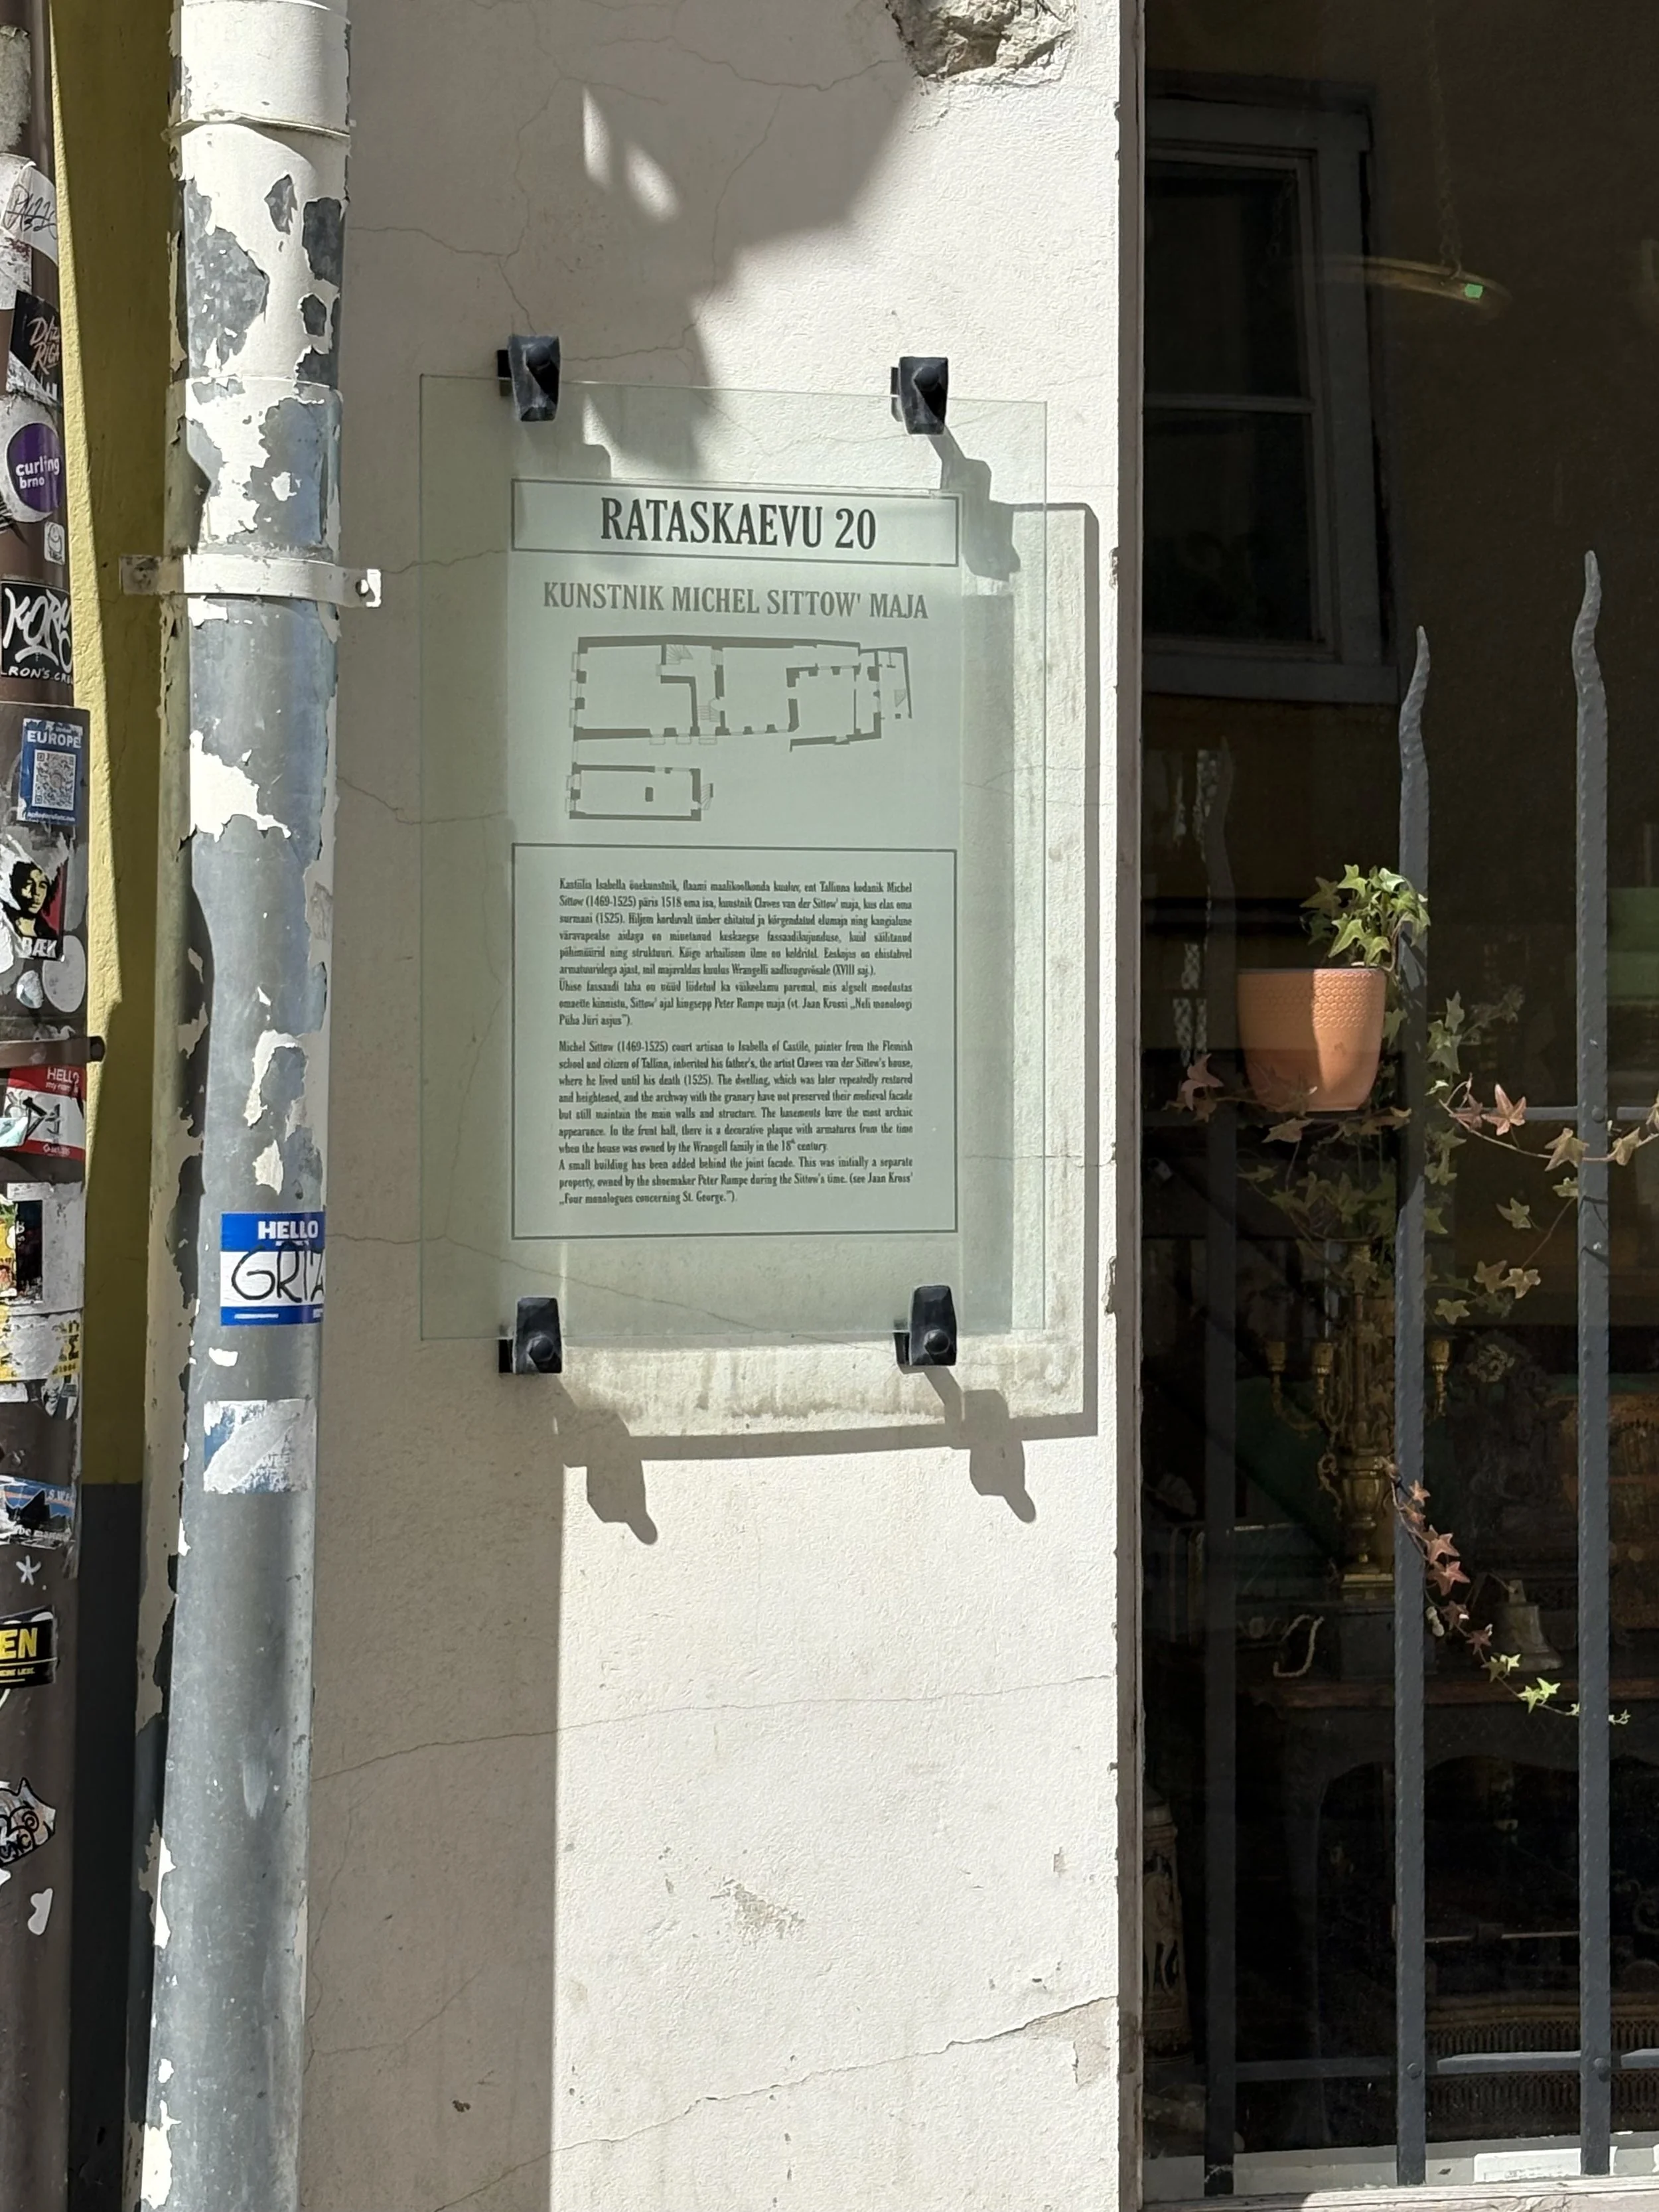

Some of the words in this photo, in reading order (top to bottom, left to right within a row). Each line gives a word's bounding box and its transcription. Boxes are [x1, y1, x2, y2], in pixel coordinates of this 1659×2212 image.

[15, 456, 60, 476] curling
[19, 477, 46, 489] brno
[599, 497, 823, 548] RATASKAEVU
[834, 508, 877, 550] 20
[543, 581, 664, 611] KUNSTNIK
[672, 585, 760, 615] MICHEL
[766, 589, 861, 617] SITTOW'
[869, 593, 929, 620] MAJA
[27, 730, 82, 749] EUROPE
[559, 1040, 587, 1052] Michel
[589, 1041, 614, 1052] Sittow
[616, 1041, 669, 1053] (1469-1525)
[671, 1043, 693, 1052] court
[695, 1041, 724, 1052] artisan
[737, 1040, 769, 1051] Isabella
[814, 1041, 843, 1055] painter
[845, 1040, 864, 1051] from
[882, 1040, 913, 1051] Flemish
[558, 1057, 585, 1069] school
[603, 1058, 630, 1069] citizen
[672, 1057, 709, 1069] inherited
[773, 1058, 796, 1068] artist
[796, 1057, 824, 1068] Clawes
[558, 1074, 583, 1086] where
[598, 1074, 618, 1086] lived
[620, 1074, 640, 1086] until
[658, 1073, 682, 1085] death
[716, 1074, 733, 1085] The
[772, 1073, 798, 1084] which
[817, 1073, 837, 1084] later
[838, 1073, 879, 1087] repeatedly
[881, 1072, 913, 1084] restored
[655, 1090, 689, 1104] archway
[689, 1090, 707, 1102] with
[723, 1094, 756, 1104] granary
[757, 1090, 776, 1102] have
[791, 1090, 831, 1104] preserved
[831, 1090, 852, 1101] their
[888, 1089, 913, 1100] facade
[595, 1108, 631, 1119] maintain
[650, 1108, 672, 1119] main
[674, 1107, 696, 1118] walls
[779, 1106, 821, 1118] basements
[824, 1106, 843, 1118] have
[862, 1108, 882, 1117] most
[885, 1106, 913, 1117] archaic
[637, 1124, 658, 1136] front
[681, 1124, 703, 1136] there
[723, 1124, 764, 1135] decorative
[766, 1124, 794, 1138] plaque
[795, 1123, 814, 1134] with
[816, 1125, 857, 1134] armatures
[859, 1122, 878, 1134] from
[896, 1123, 913, 1134] time
[558, 1142, 581, 1153] when
[596, 1142, 621, 1153] house
[638, 1141, 666, 1153] owned
[691, 1140, 729, 1154] Wrangell
[729, 1140, 755, 1154] family
[568, 1159, 591, 1170] small
[593, 1159, 629, 1173] building
[648, 1158, 669, 1169] been
[671, 1157, 696, 1169] added
[698, 1157, 727, 1169] behind
[745, 1157, 764, 1171] joint
[798, 1156, 817, 1167] This
[837, 1155, 869, 1169] initially
[879, 1157, 913, 1169] separate
[596, 1175, 624, 1187] owned
[651, 1174, 697, 1186] shoemaker
[697, 1174, 719, 1185] Peter
[719, 1174, 749, 1187] Rumpe
[750, 1173, 778, 1187] during
[849, 1173, 866, 1184] (see
[867, 1172, 887, 1183] Jaan
[585, 1192, 634, 1206] monologues
[634, 1191, 682, 1205] concerning
[257, 1220, 319, 1240] HELLO
